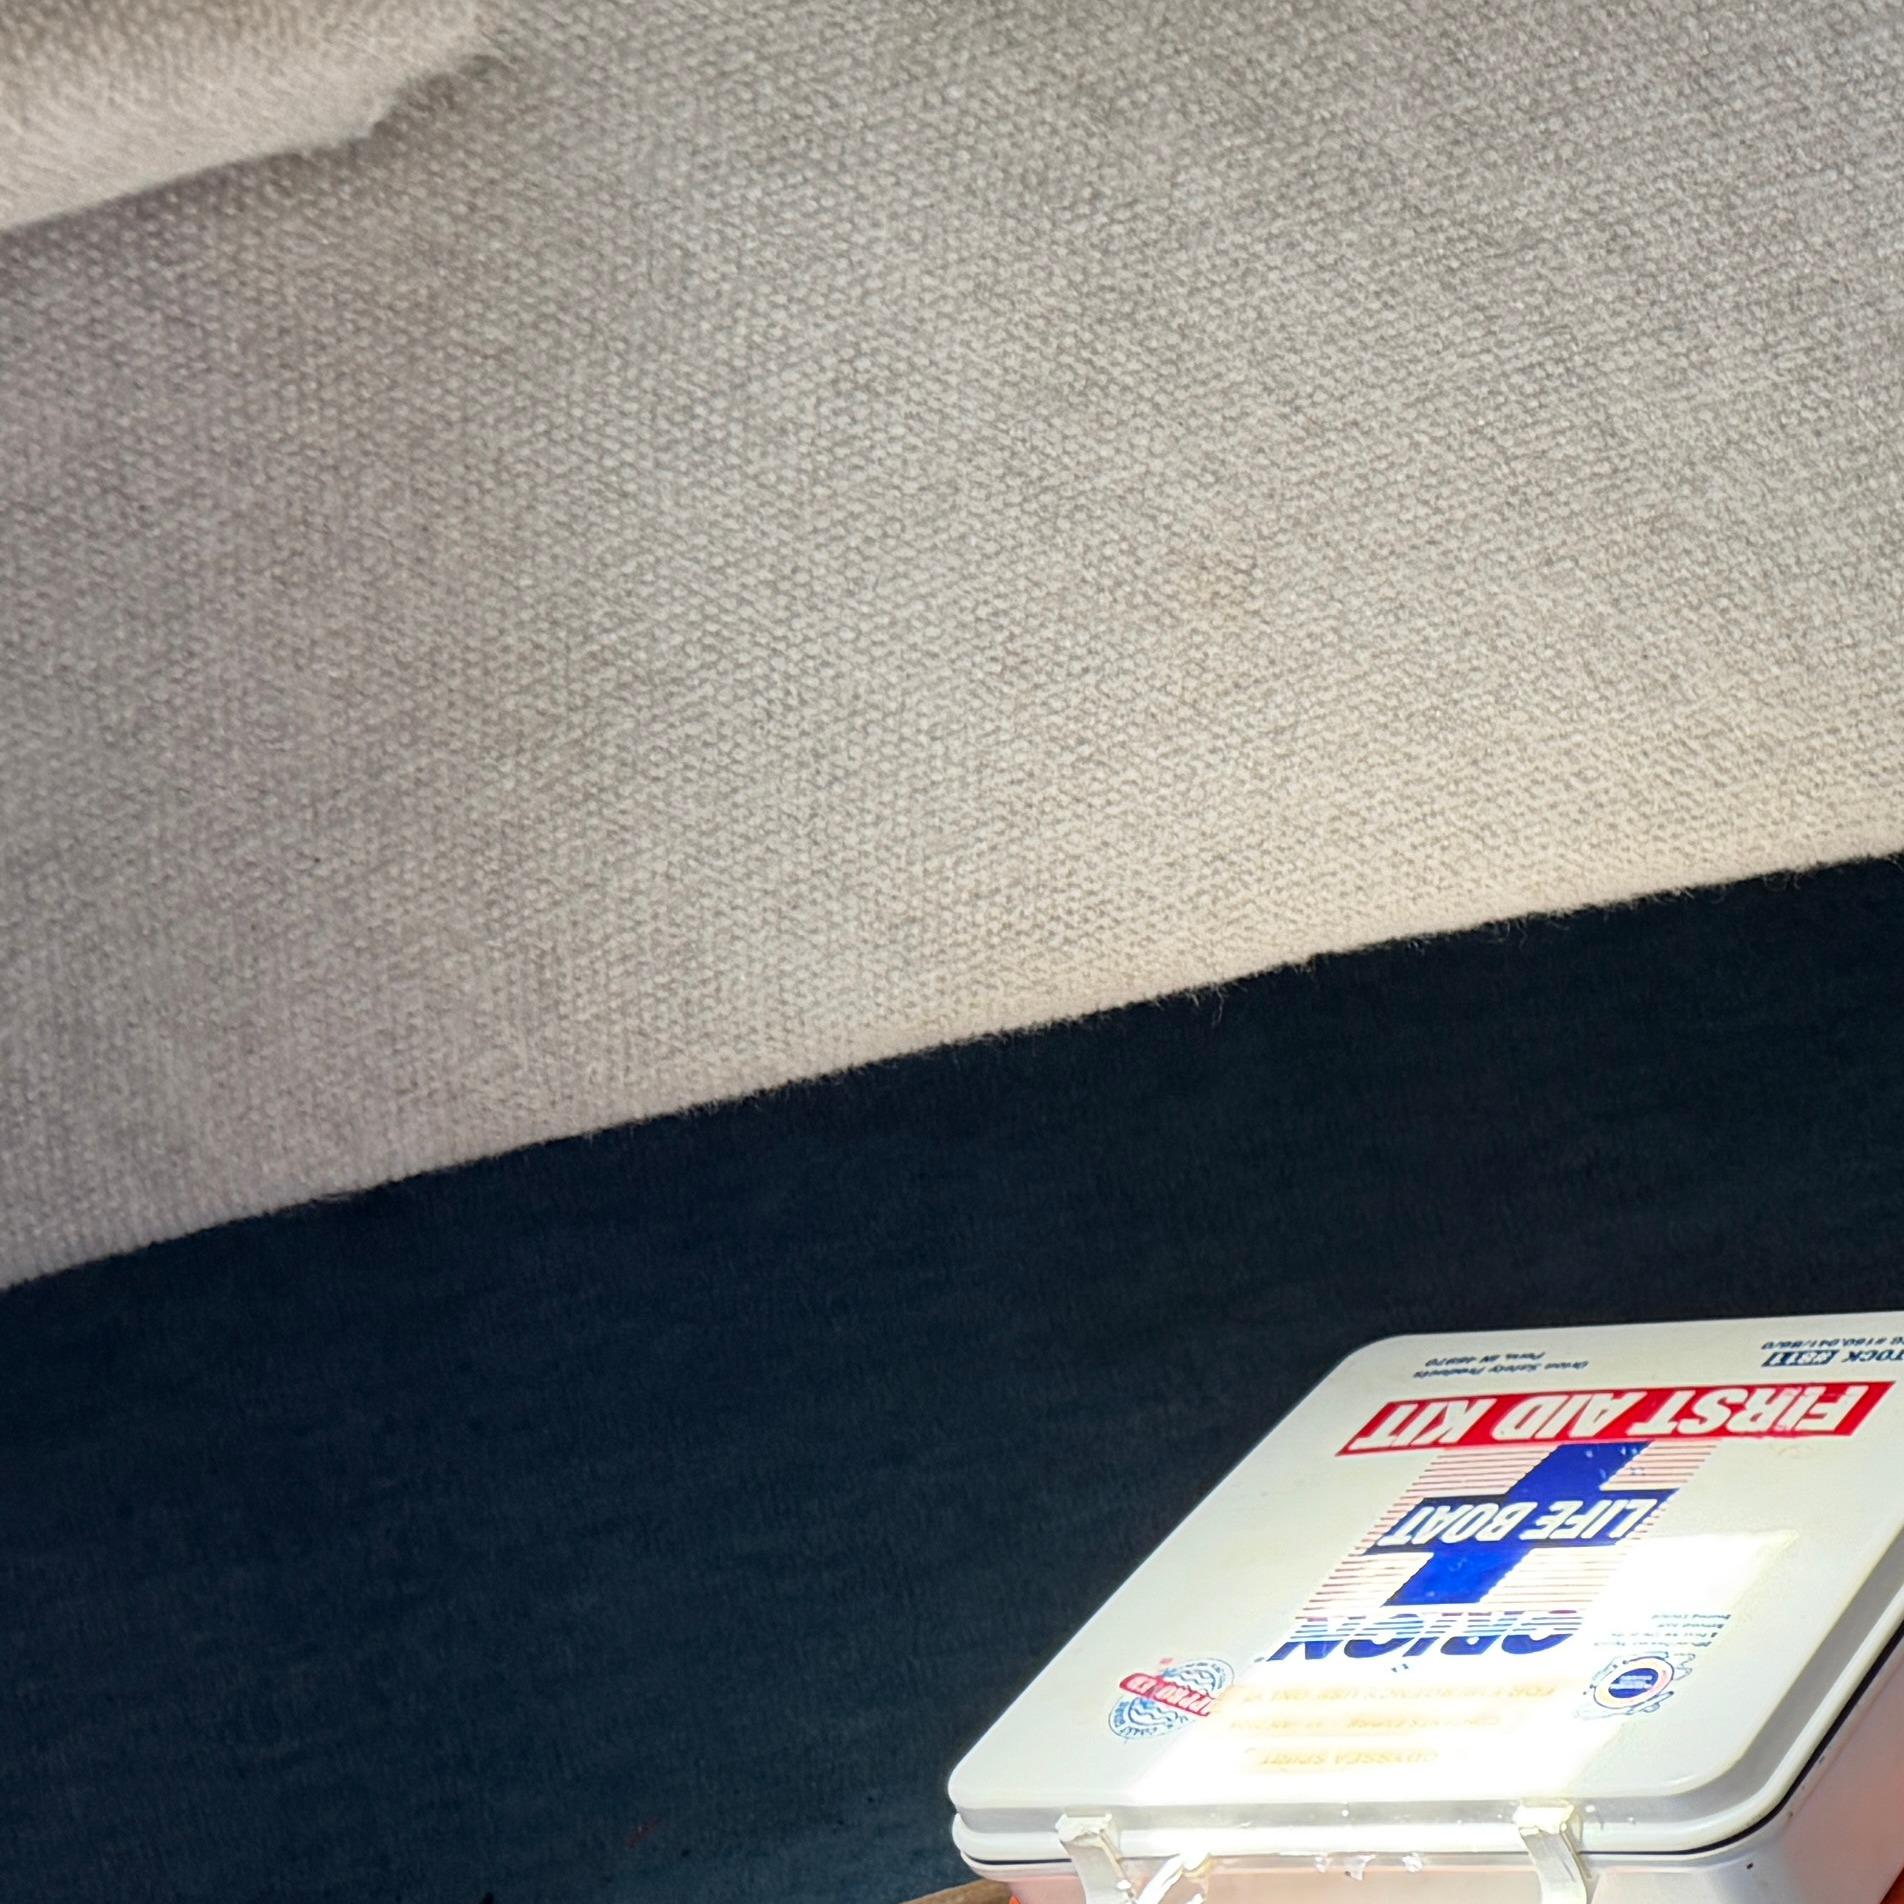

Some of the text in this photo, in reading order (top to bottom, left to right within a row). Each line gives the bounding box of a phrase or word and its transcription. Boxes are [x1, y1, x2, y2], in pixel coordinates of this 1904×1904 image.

[1360, 1383, 1870, 1446] FIRST AID KIT
[1382, 1496, 1656, 1548] LIFE BOAT
[1266, 1608, 1588, 1663] ORION
